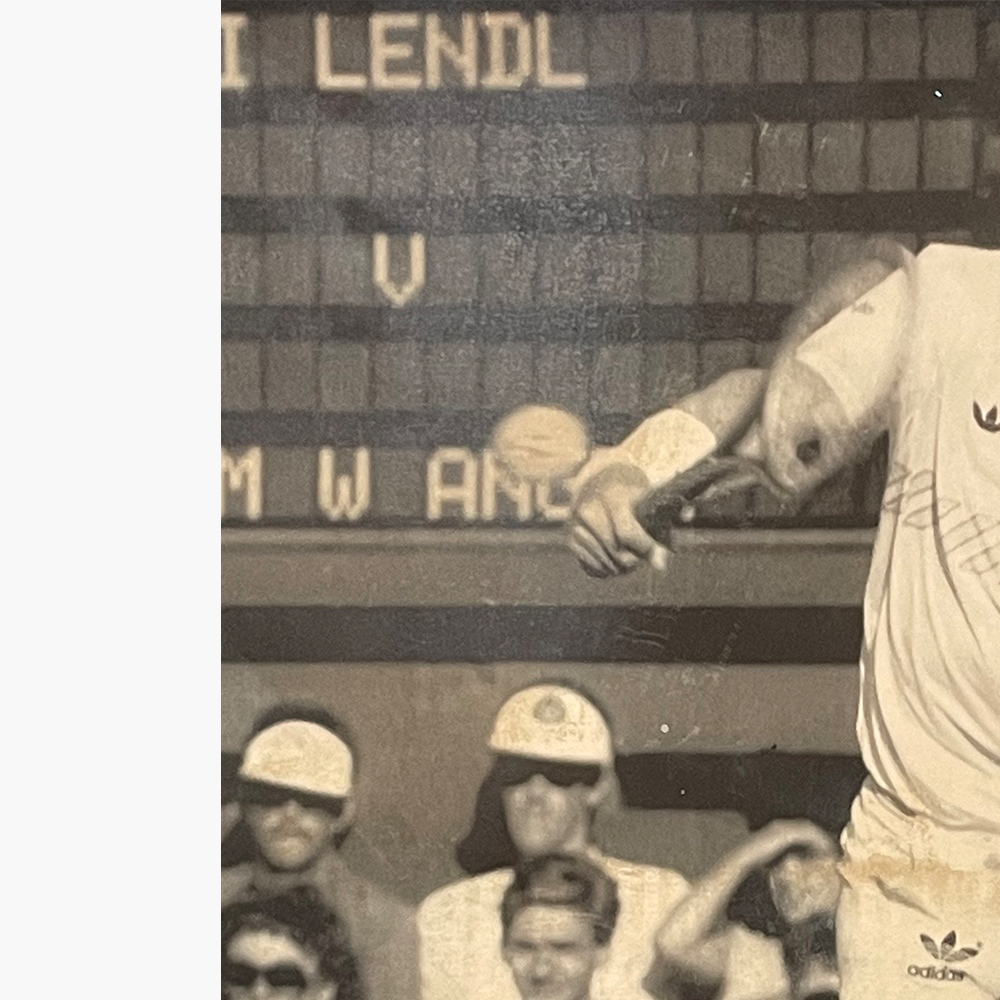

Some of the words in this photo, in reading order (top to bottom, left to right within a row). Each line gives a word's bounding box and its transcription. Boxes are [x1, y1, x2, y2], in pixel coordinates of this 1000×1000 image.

[313, 11, 589, 90] LENDL
[373, 232, 425, 308] V
[221, 446, 262, 520] M
[318, 446, 371, 521] W
[908, 963, 965, 982] adidas
